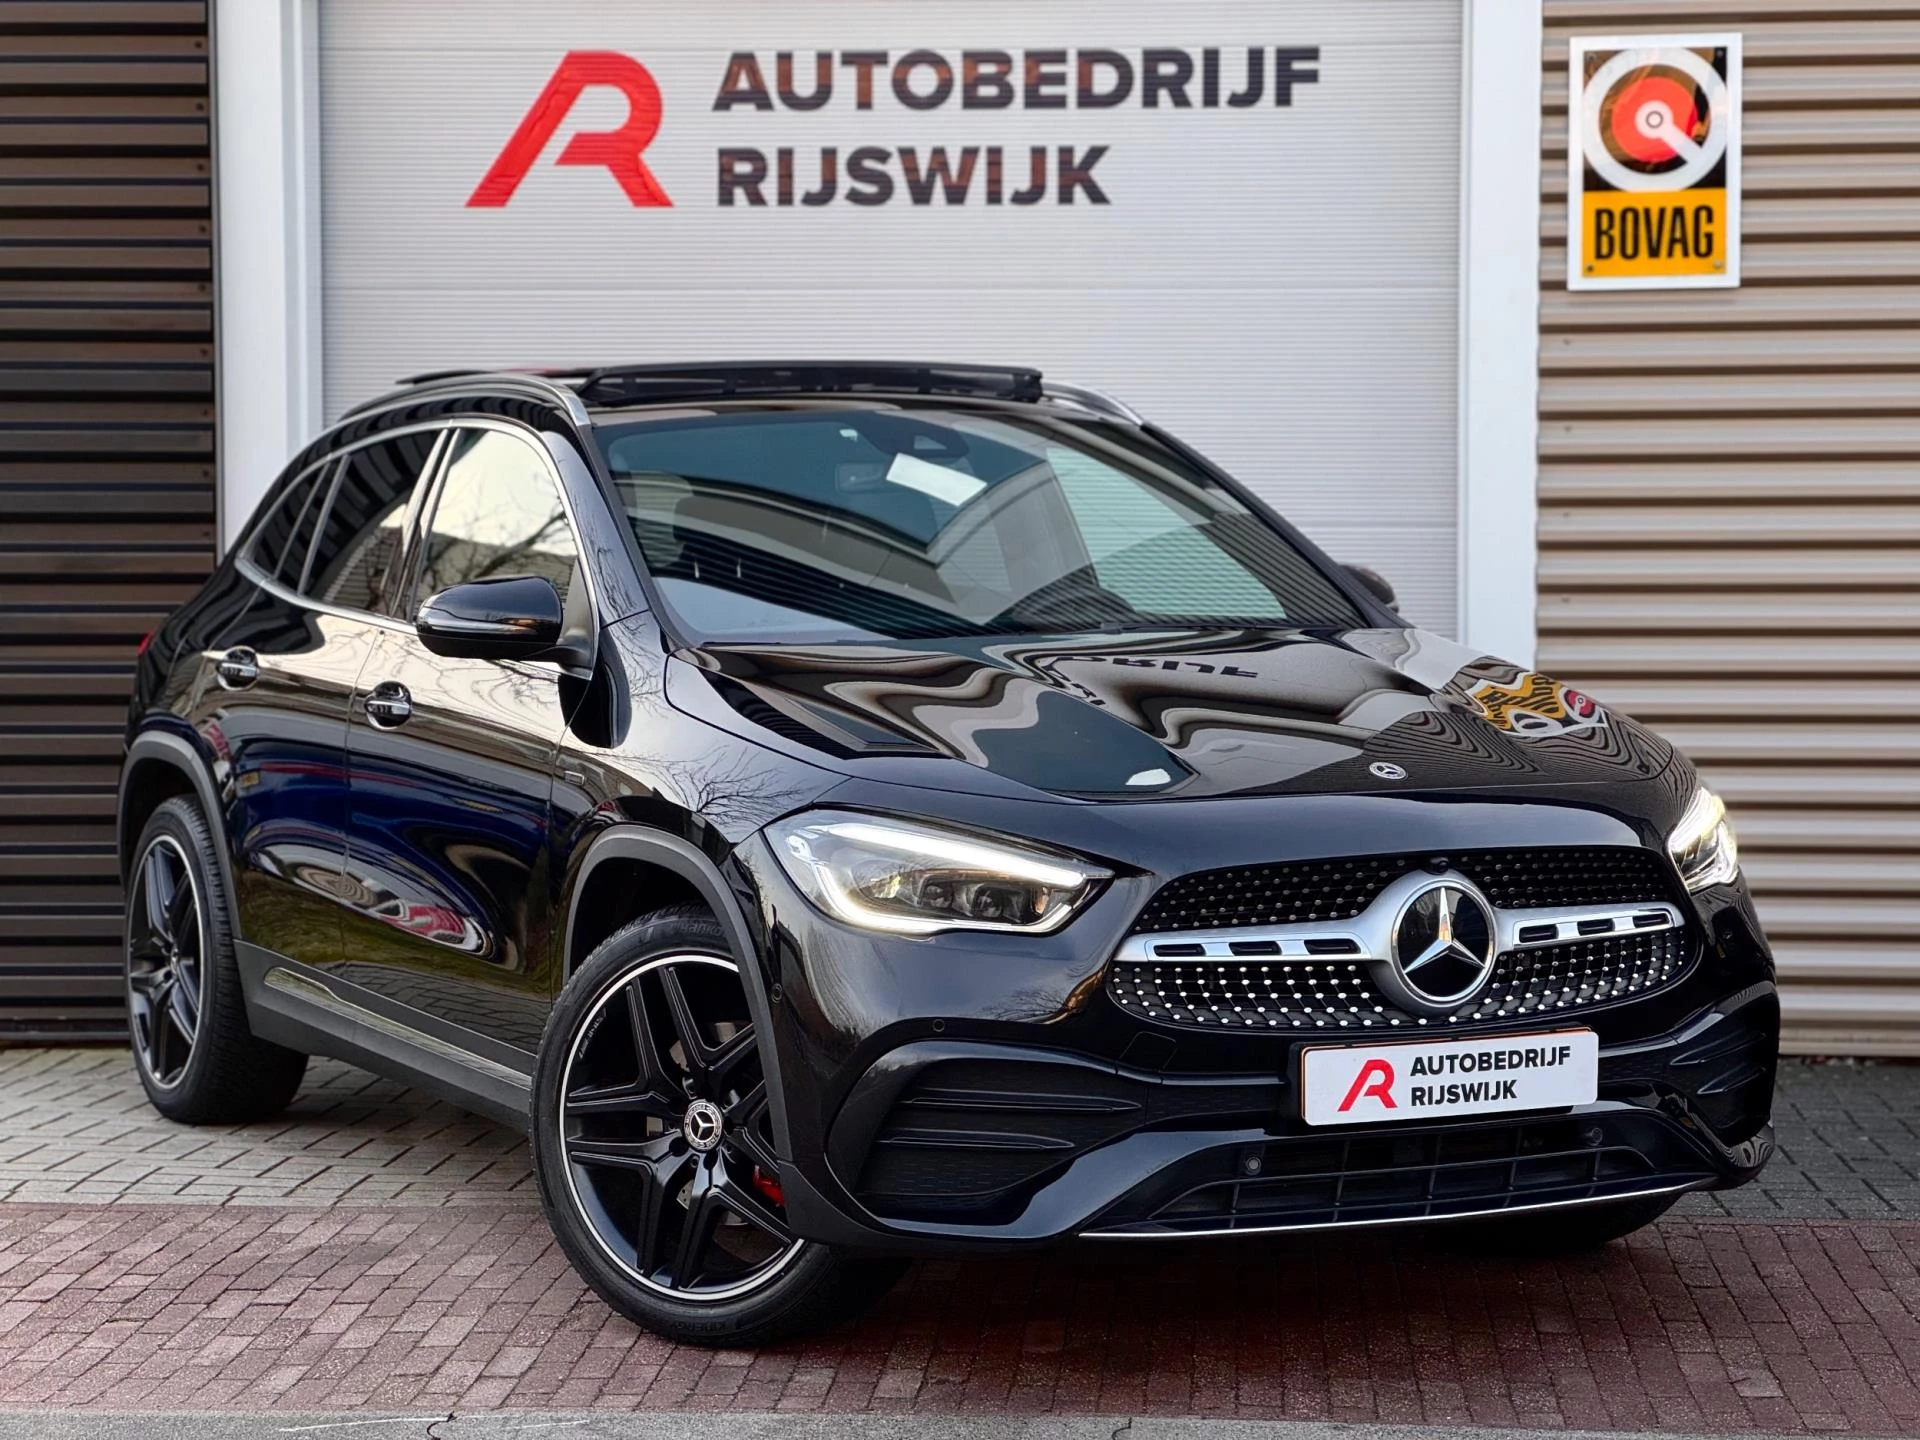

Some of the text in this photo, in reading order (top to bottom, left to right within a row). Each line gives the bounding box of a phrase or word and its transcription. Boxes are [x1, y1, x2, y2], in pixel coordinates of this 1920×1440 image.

[713, 47, 1319, 111] AUTOBEDRIJF
[718, 146, 1109, 206] RIJSWIJK
[1595, 204, 1714, 260] BOVAG
[1410, 1045, 1571, 1077] AUTOBEDRIJF
[1411, 1079, 1518, 1107] RIJSWIJK
